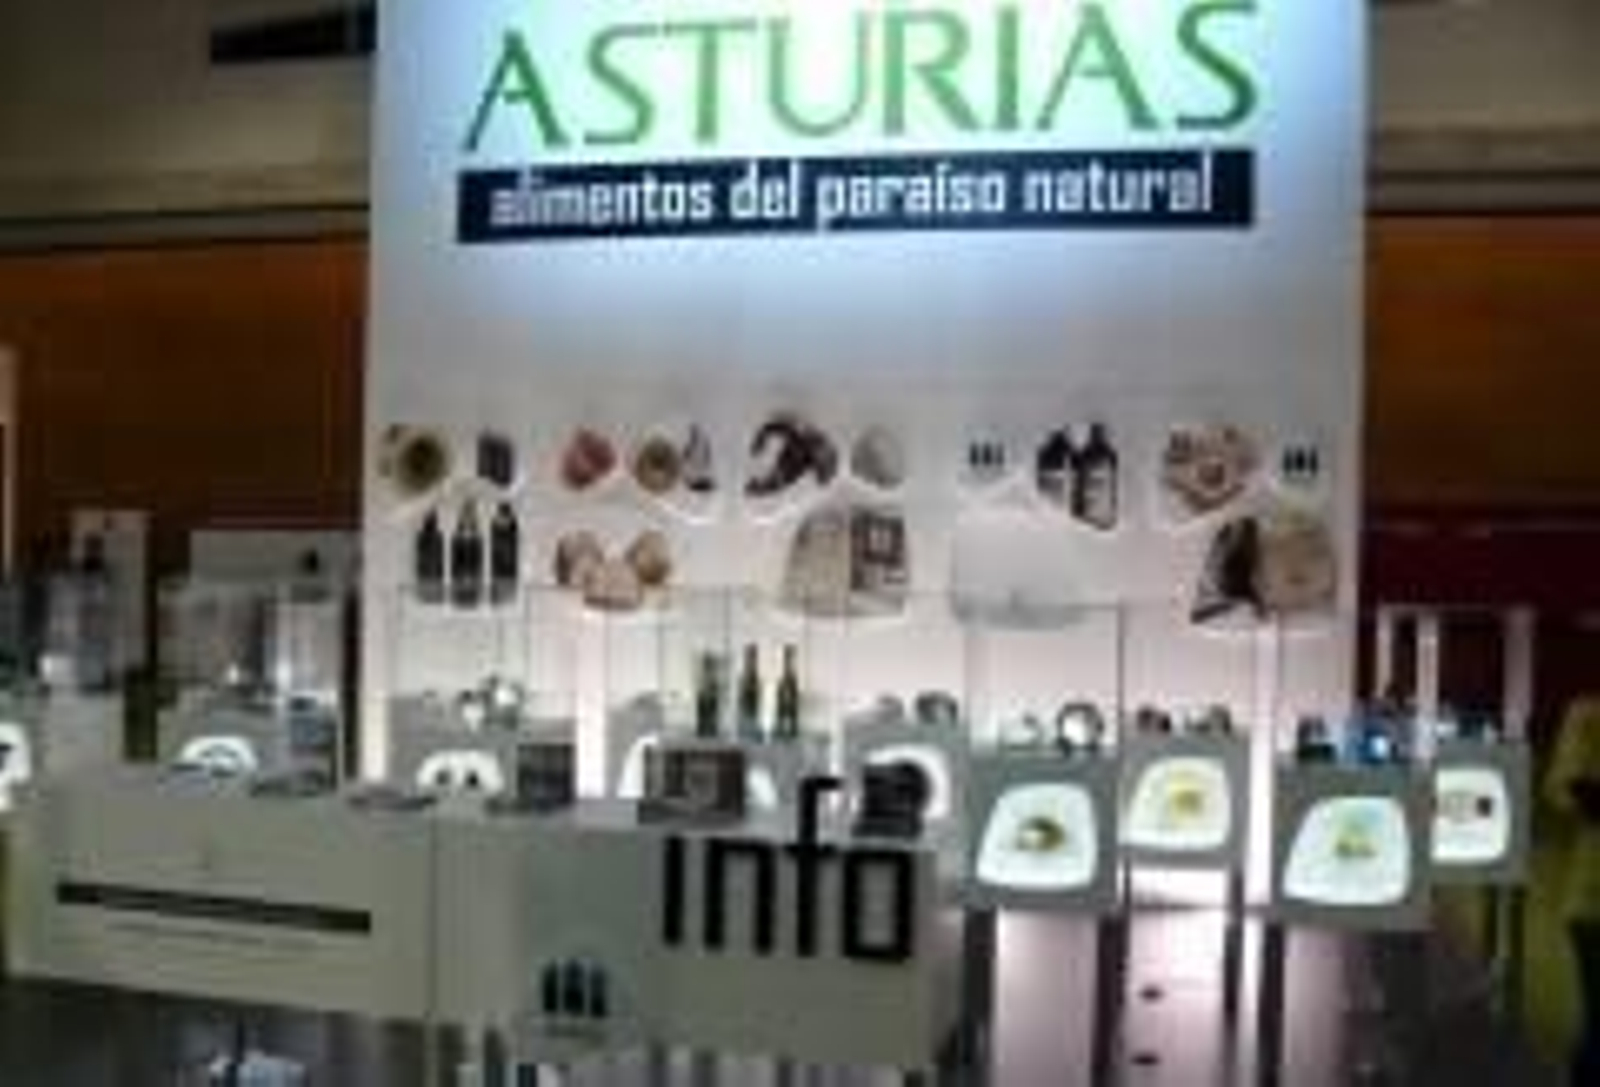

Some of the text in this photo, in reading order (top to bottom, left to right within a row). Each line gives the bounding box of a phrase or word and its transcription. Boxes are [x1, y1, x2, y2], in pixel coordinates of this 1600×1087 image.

[463, 0, 1259, 152] ASTURIAS
[490, 168, 713, 225] alimentos
[731, 159, 799, 219] del
[1023, 153, 1213, 212] natural
[663, 776, 915, 963] info
